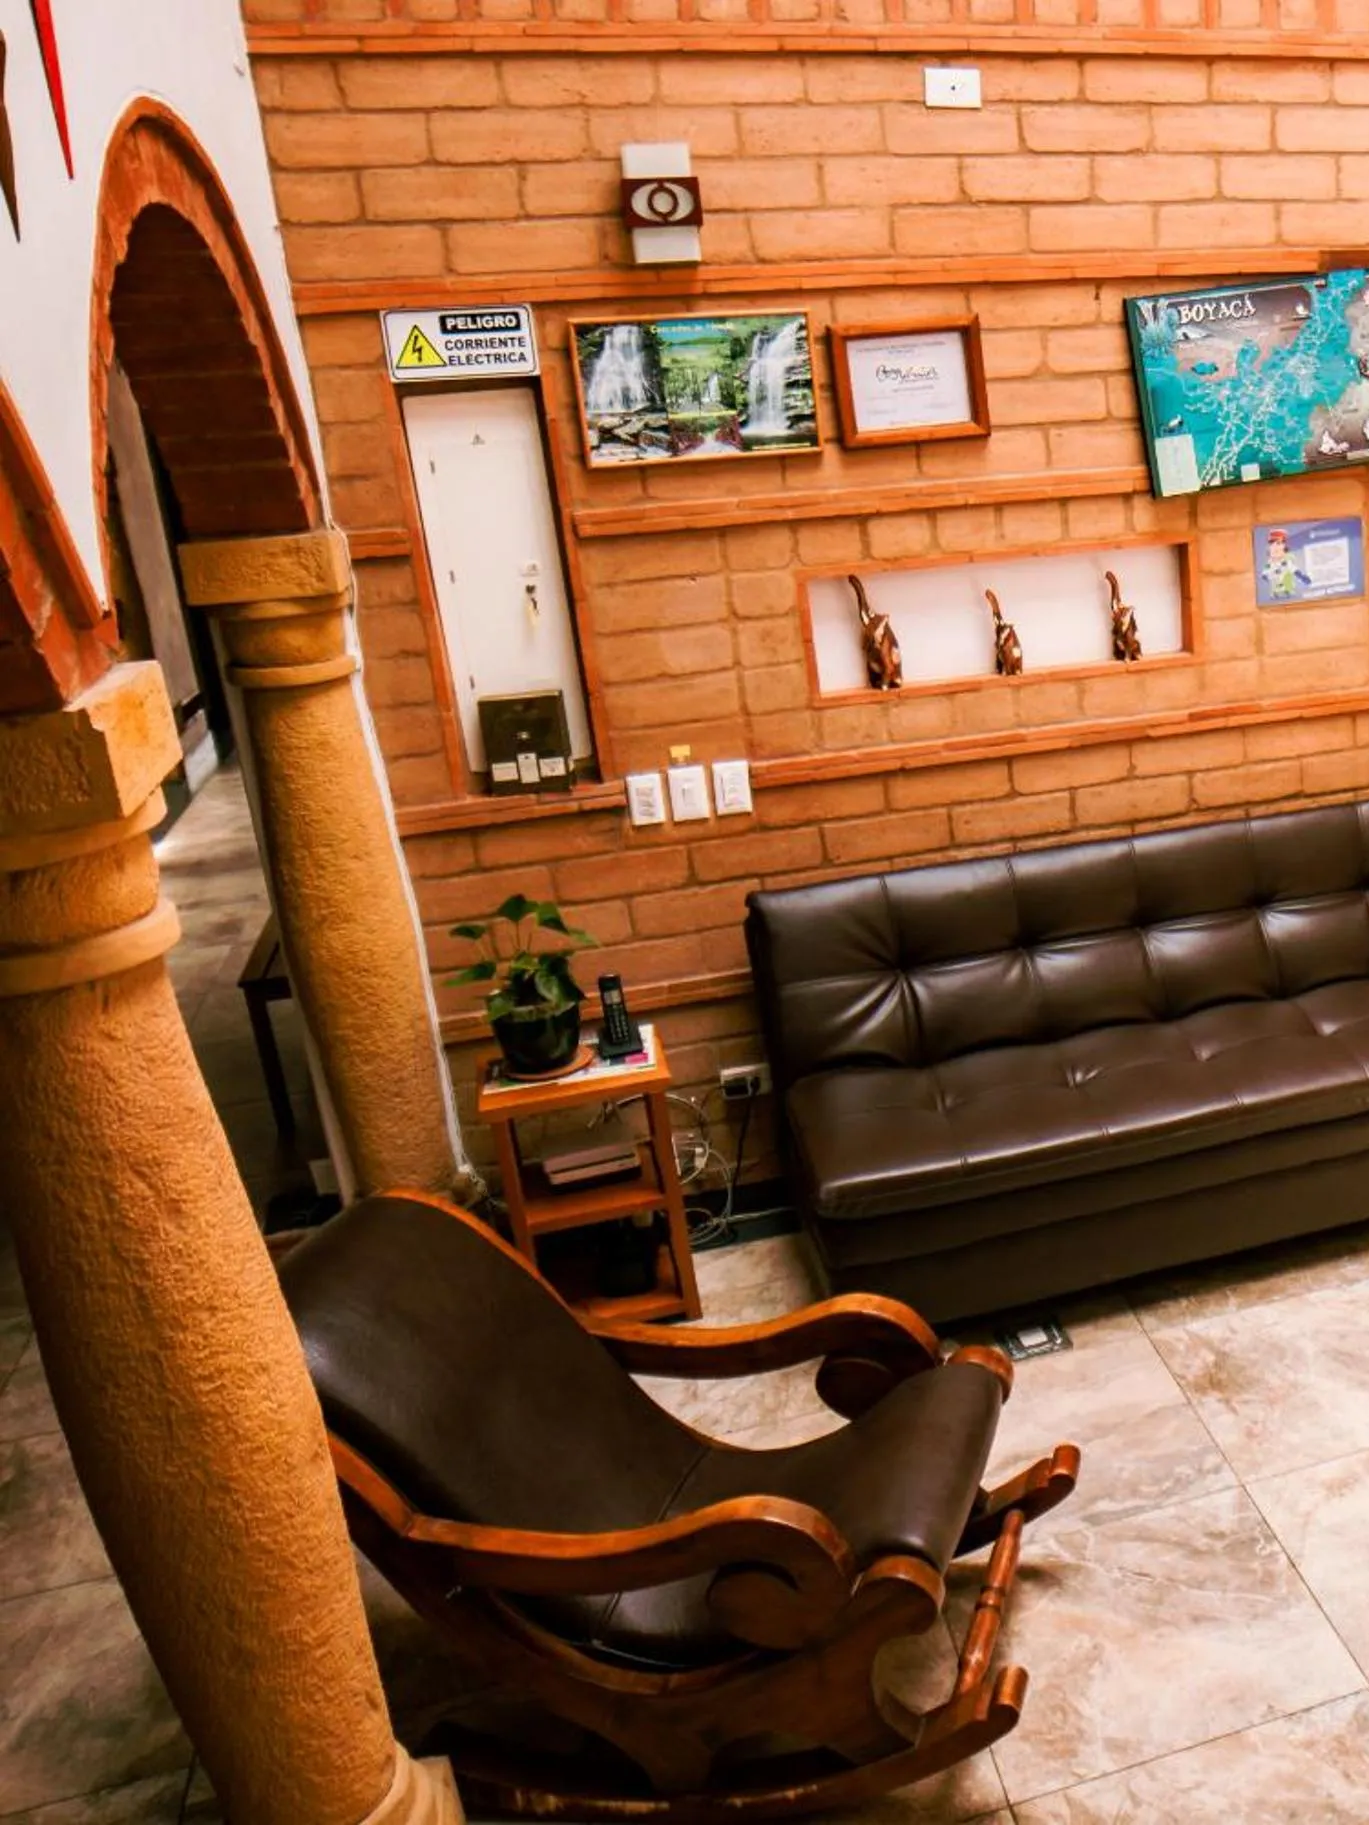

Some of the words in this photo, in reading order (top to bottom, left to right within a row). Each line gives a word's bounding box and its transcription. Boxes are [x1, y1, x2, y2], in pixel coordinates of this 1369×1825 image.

[1178, 294, 1257, 325] BOYACÁ
[445, 315, 517, 330] PELIGRO
[444, 336, 527, 351] CORRIENTE
